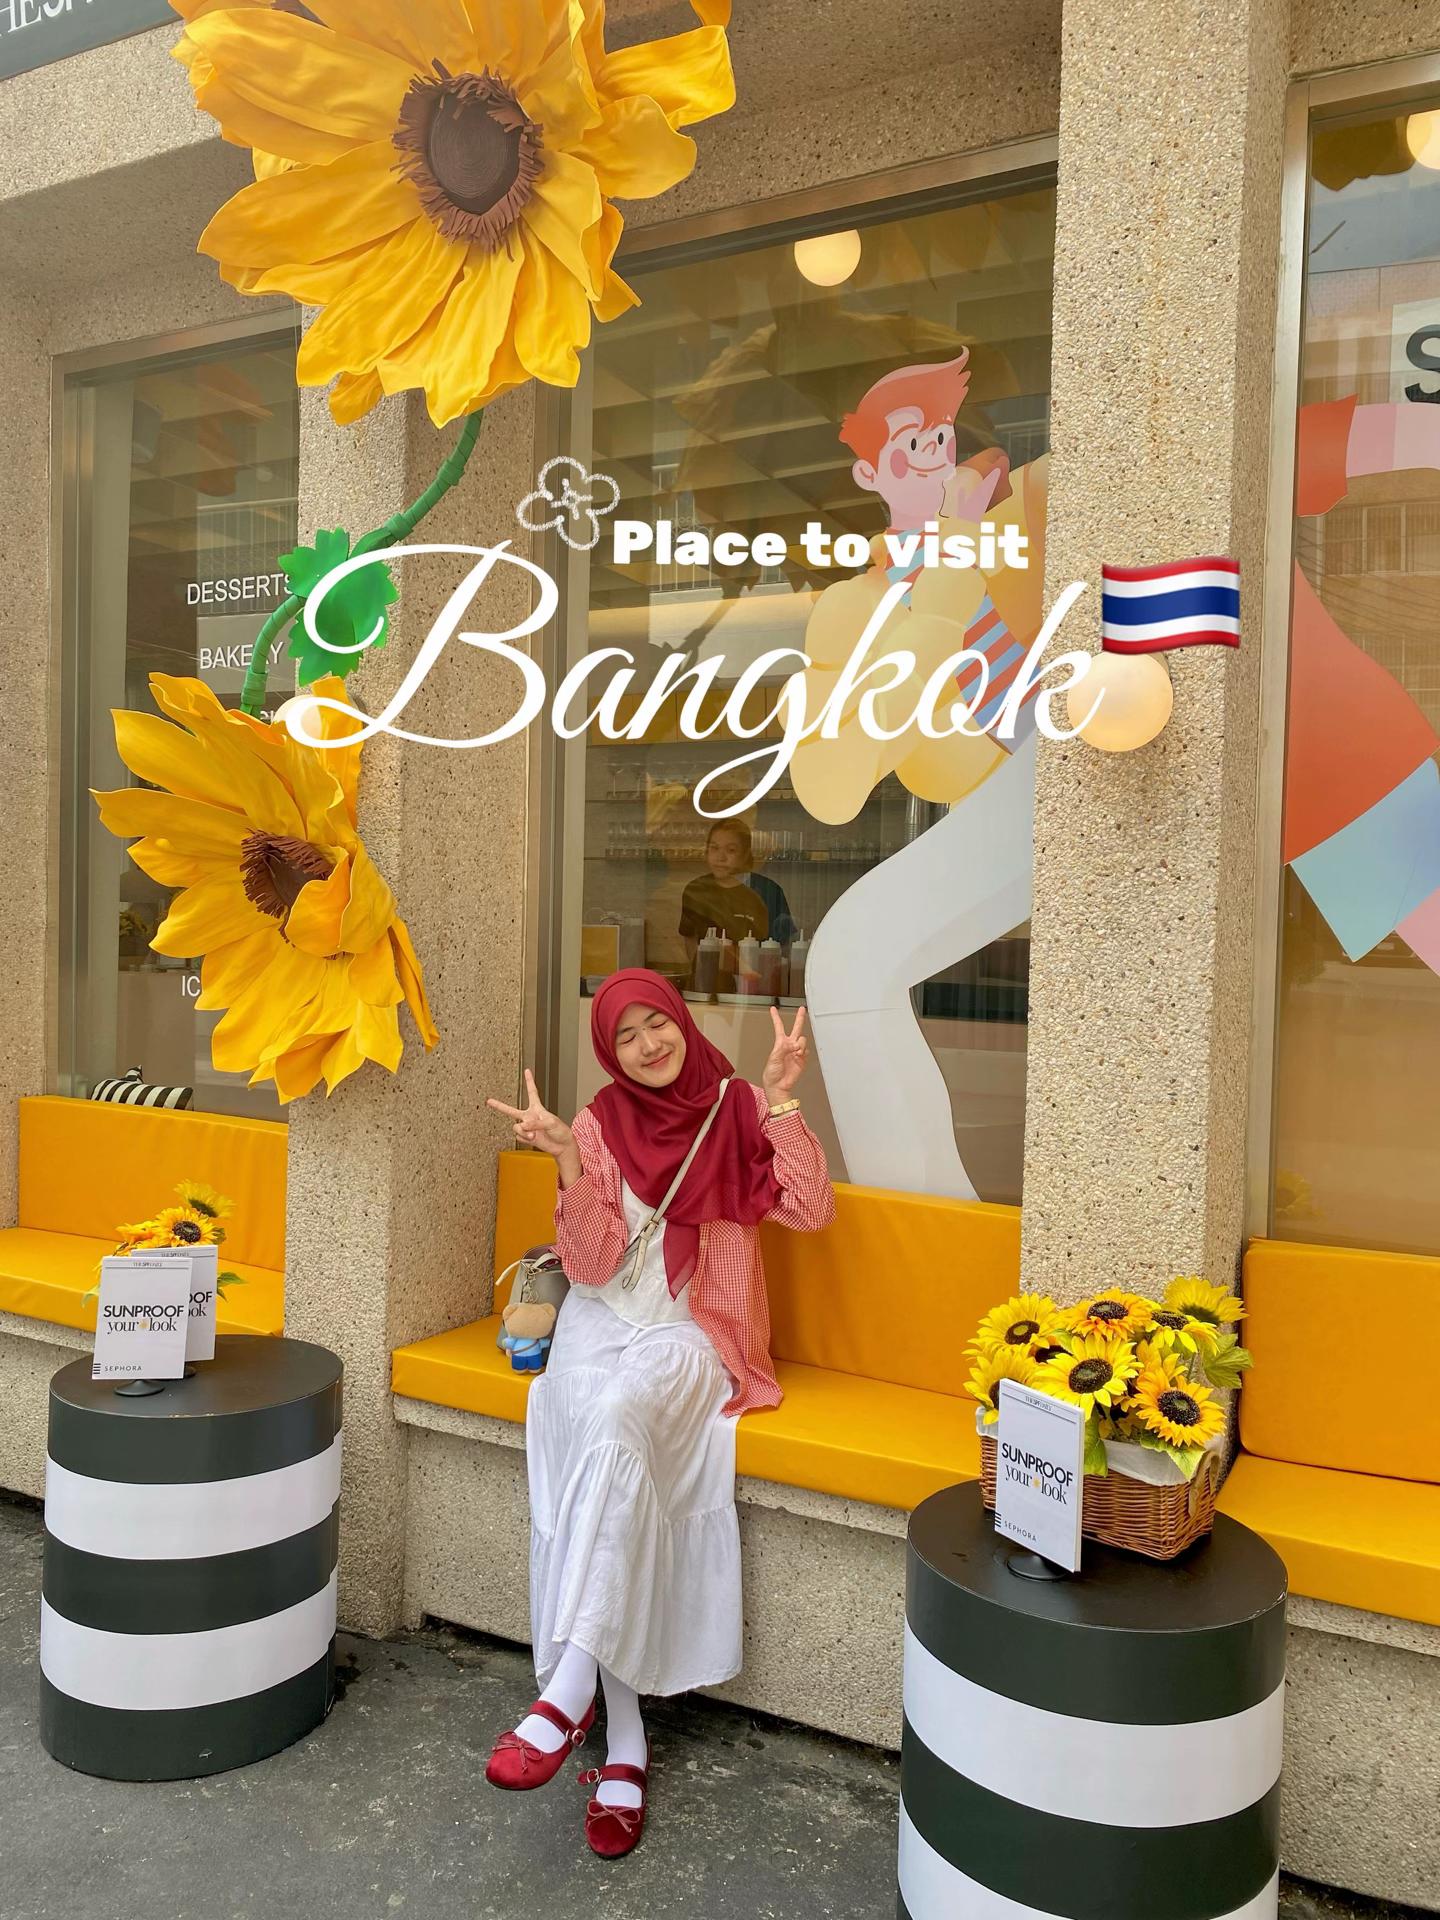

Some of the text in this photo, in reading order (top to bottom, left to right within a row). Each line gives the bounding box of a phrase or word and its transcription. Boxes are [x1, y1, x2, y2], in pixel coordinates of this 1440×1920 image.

[200, 642, 283, 670] BAKEY
[103, 1304, 185, 1318] SUNPROOF
[107, 1317, 177, 1334] your look
[1001, 1442, 1074, 1487] SUNPROOF
[1005, 1464, 1068, 1505] your look
[1004, 1520, 1037, 1542] SEPHORA
